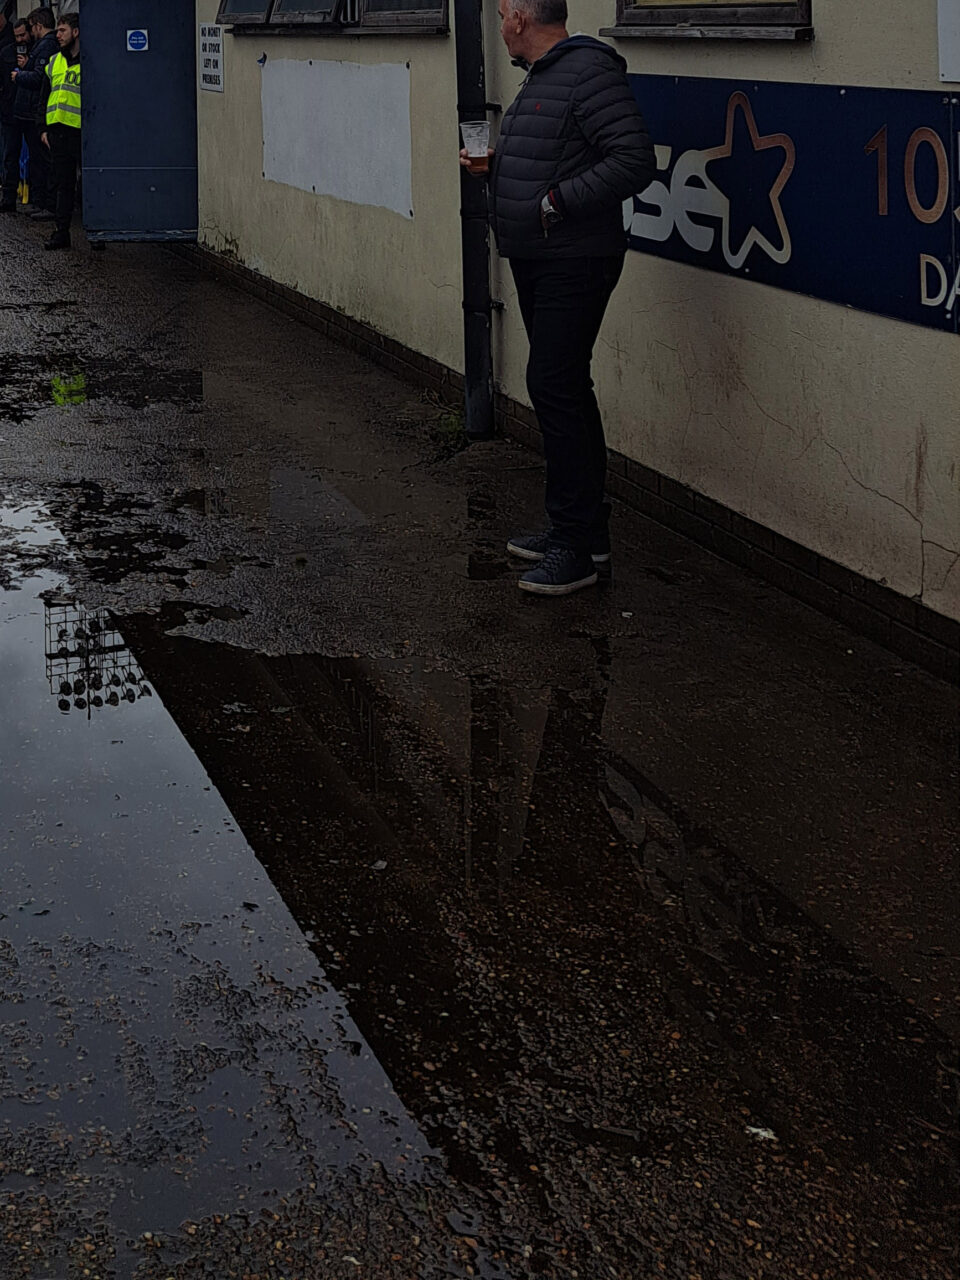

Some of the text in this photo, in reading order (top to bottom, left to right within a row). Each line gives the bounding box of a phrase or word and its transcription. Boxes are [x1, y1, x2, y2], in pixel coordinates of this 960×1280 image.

[201, 26, 221, 38] NO MONEY
[202, 42, 221, 54] OR STOCK
[203, 58, 219, 69] LEFT ON
[202, 73, 221, 86] PREMISES
[864, 123, 960, 225] 10
[622, 143, 731, 252] se
